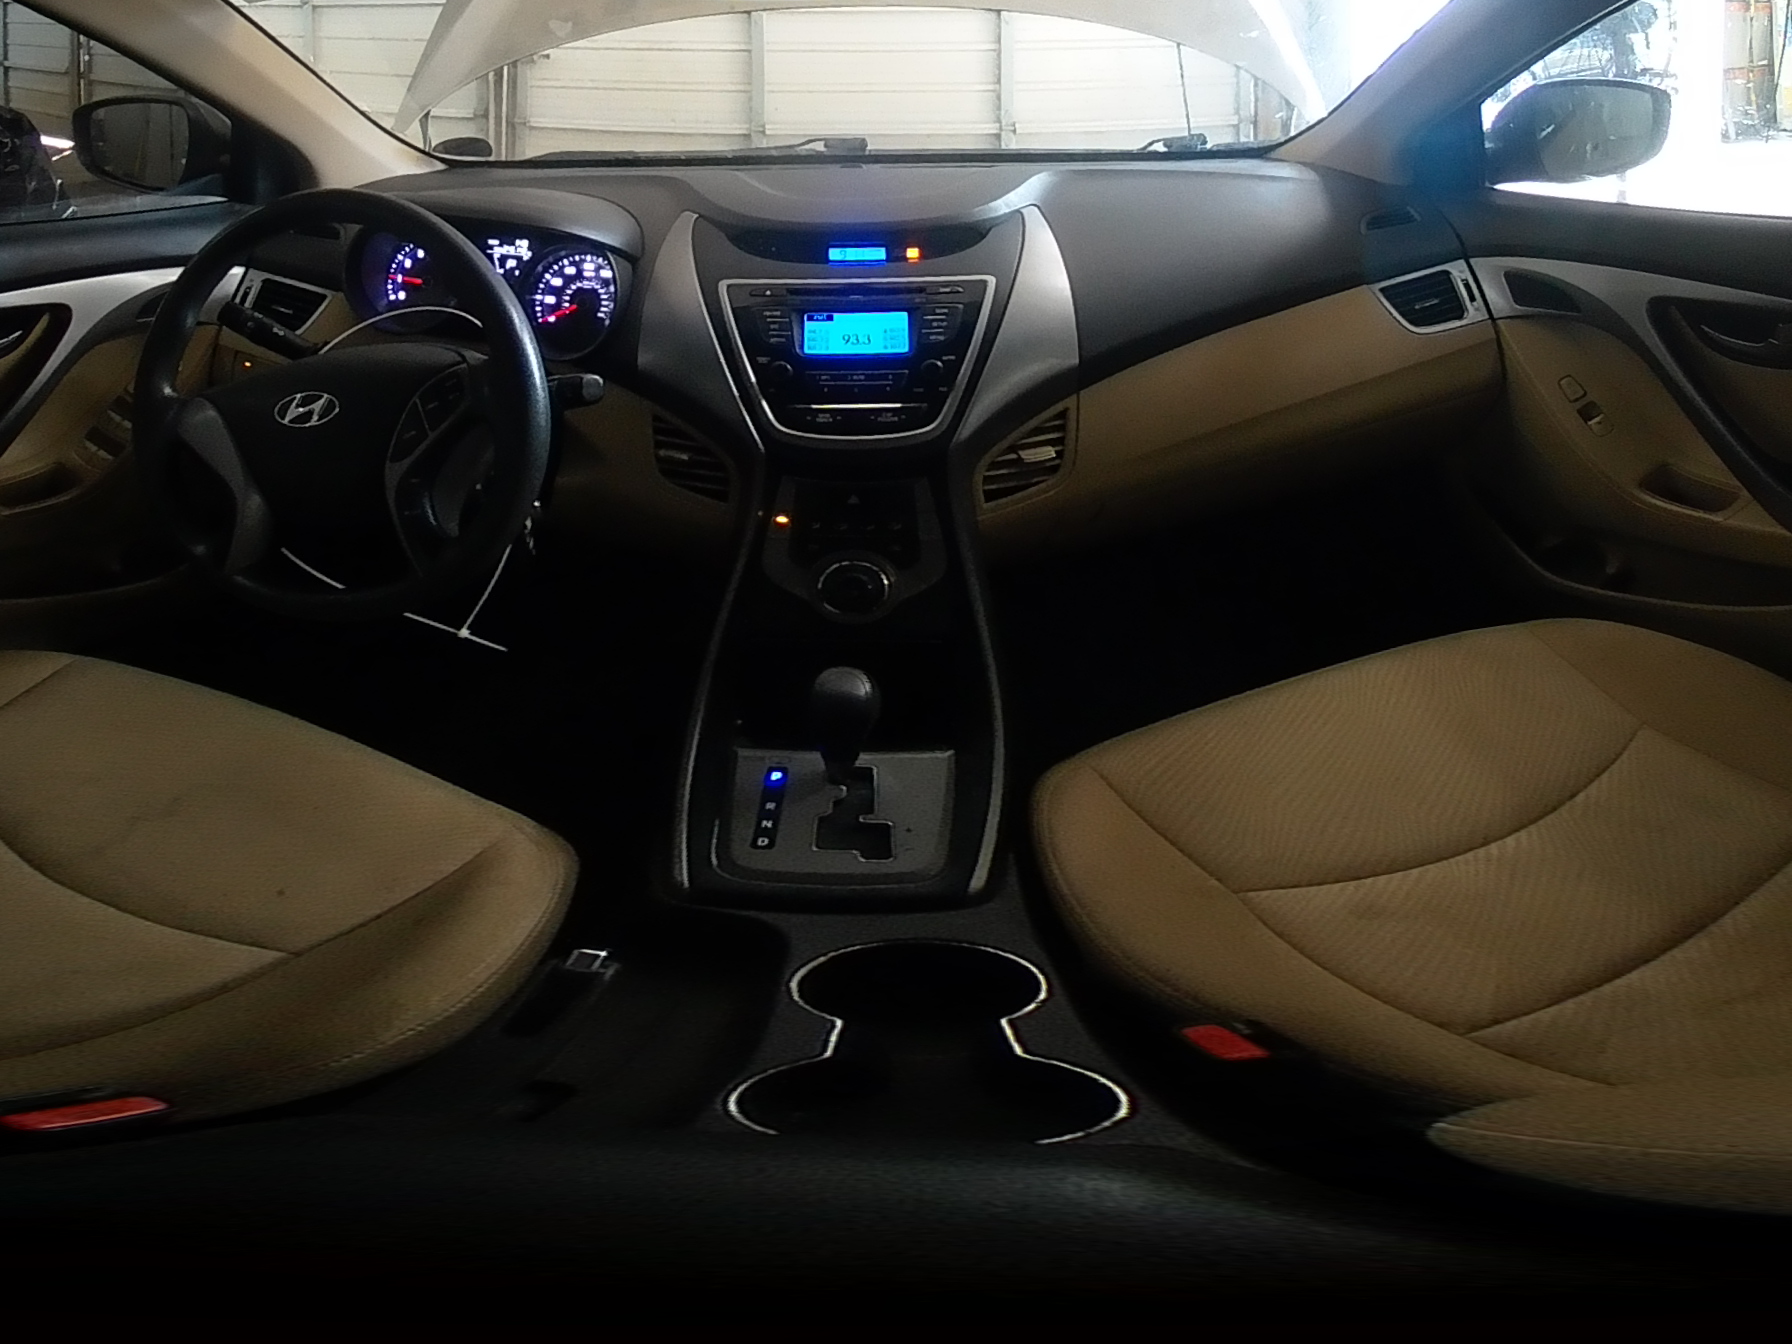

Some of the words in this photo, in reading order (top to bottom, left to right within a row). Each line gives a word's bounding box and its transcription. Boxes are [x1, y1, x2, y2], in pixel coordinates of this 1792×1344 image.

[842, 333, 872, 346] 93.3
[770, 771, 783, 781] P
[764, 802, 776, 810] R
[761, 820, 773, 828] N
[757, 837, 770, 846] D
